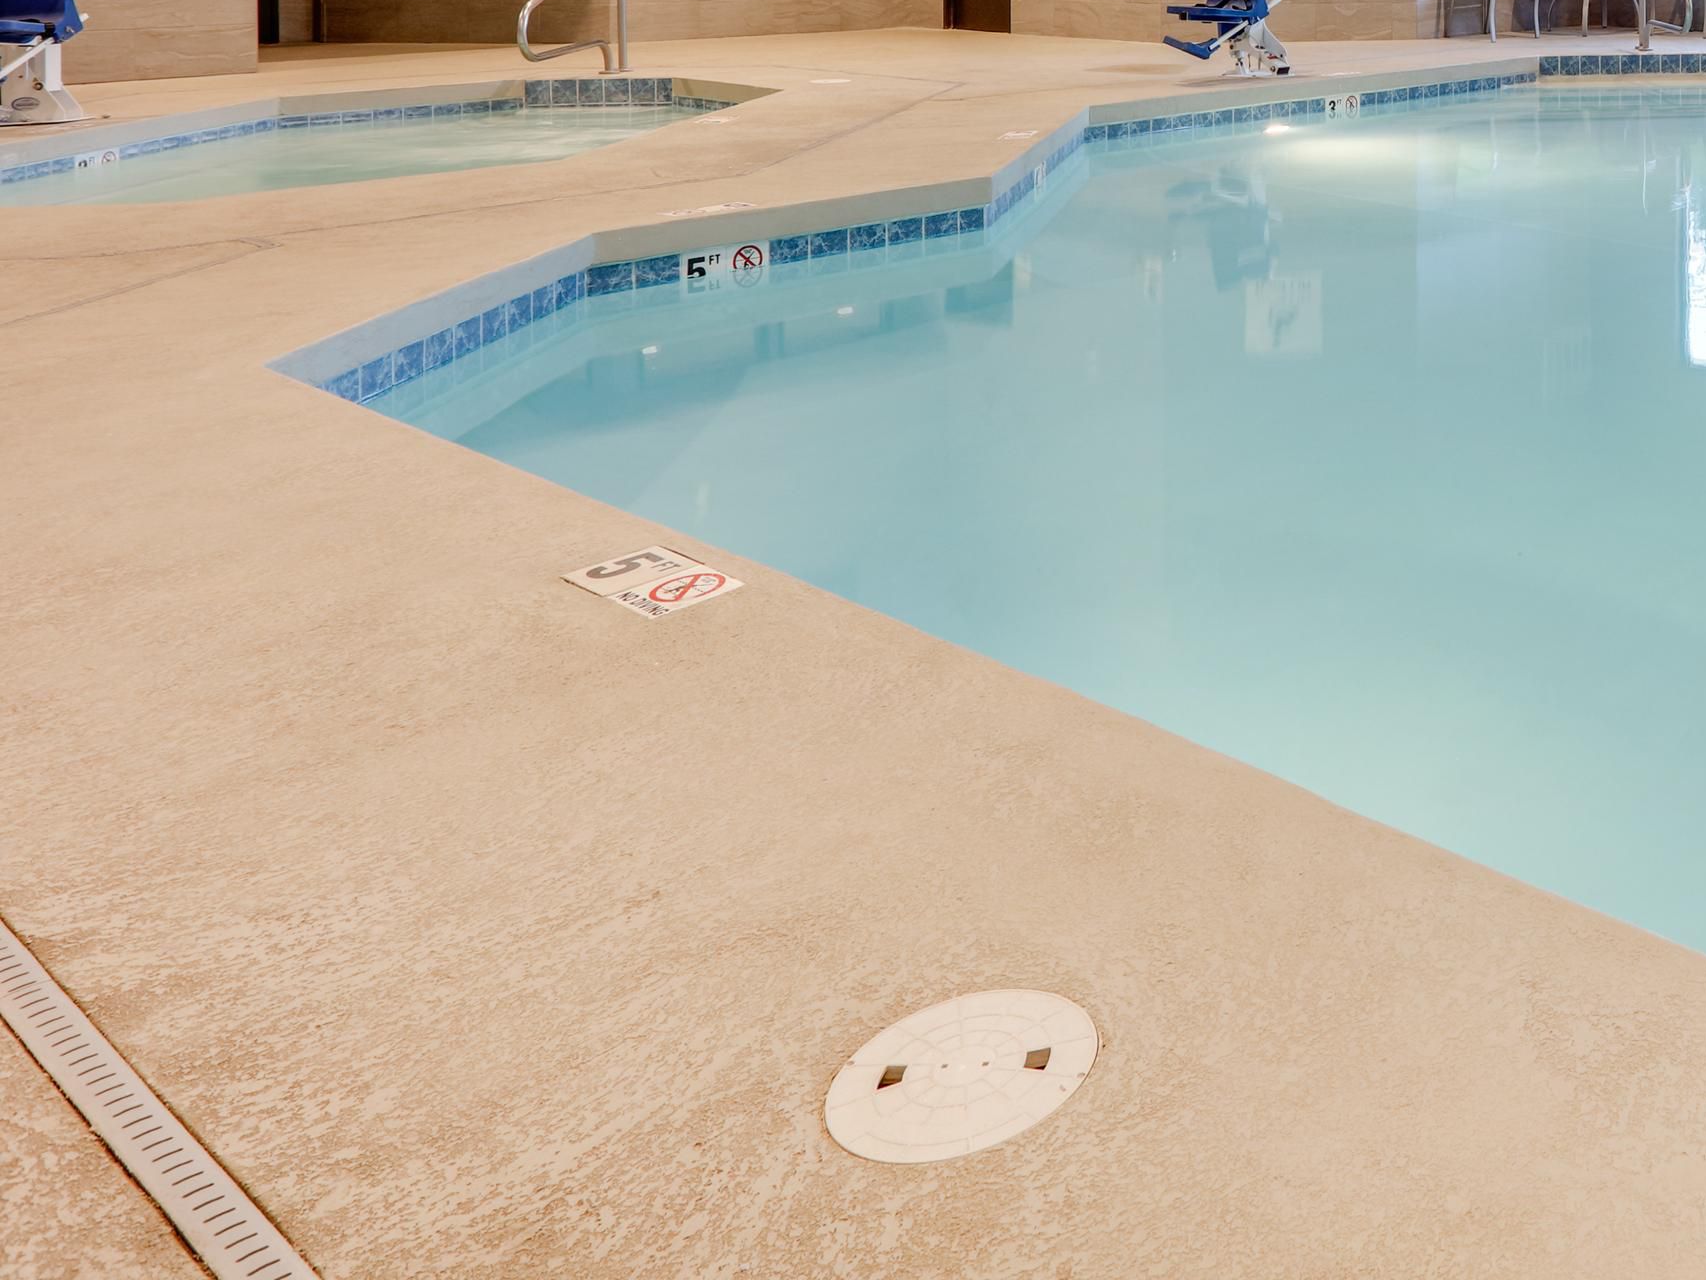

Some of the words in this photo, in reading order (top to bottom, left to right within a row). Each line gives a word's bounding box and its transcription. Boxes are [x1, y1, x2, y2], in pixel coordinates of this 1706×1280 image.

[687, 256, 706, 280] 5
[708, 254, 721, 266] FT
[586, 552, 665, 579] 5
[650, 561, 682, 572] FT
[616, 591, 640, 602] NO
[630, 597, 669, 616] DIVING
